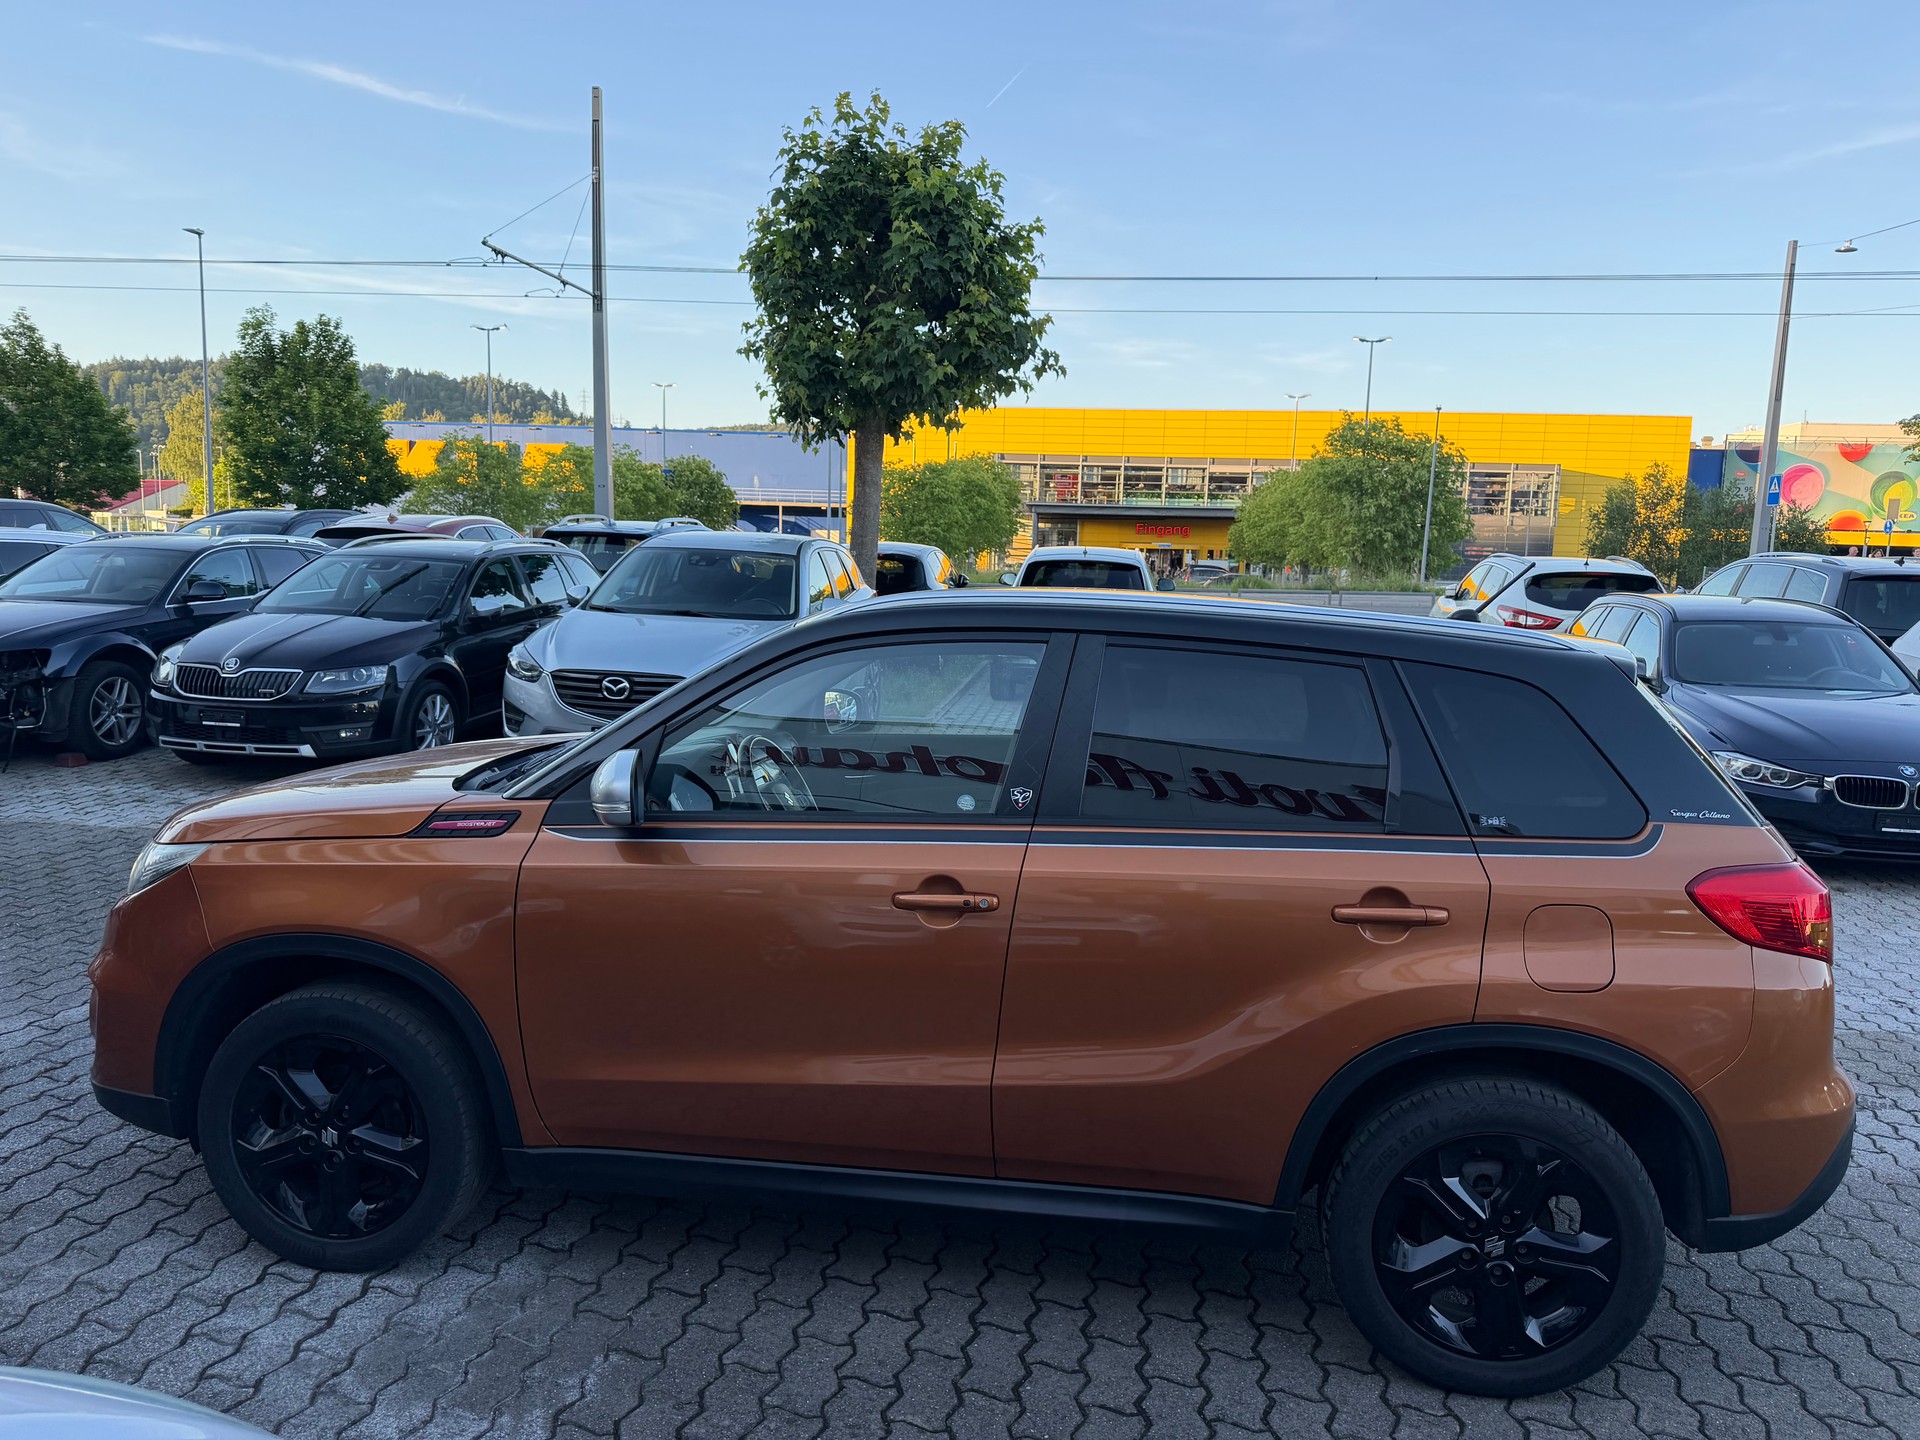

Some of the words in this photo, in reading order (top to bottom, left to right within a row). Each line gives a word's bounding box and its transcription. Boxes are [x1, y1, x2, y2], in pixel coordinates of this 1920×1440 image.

[1135, 523, 1191, 538] Eingang
[1670, 808, 1698, 819] Sergio
[1699, 810, 1731, 819] Cellano
